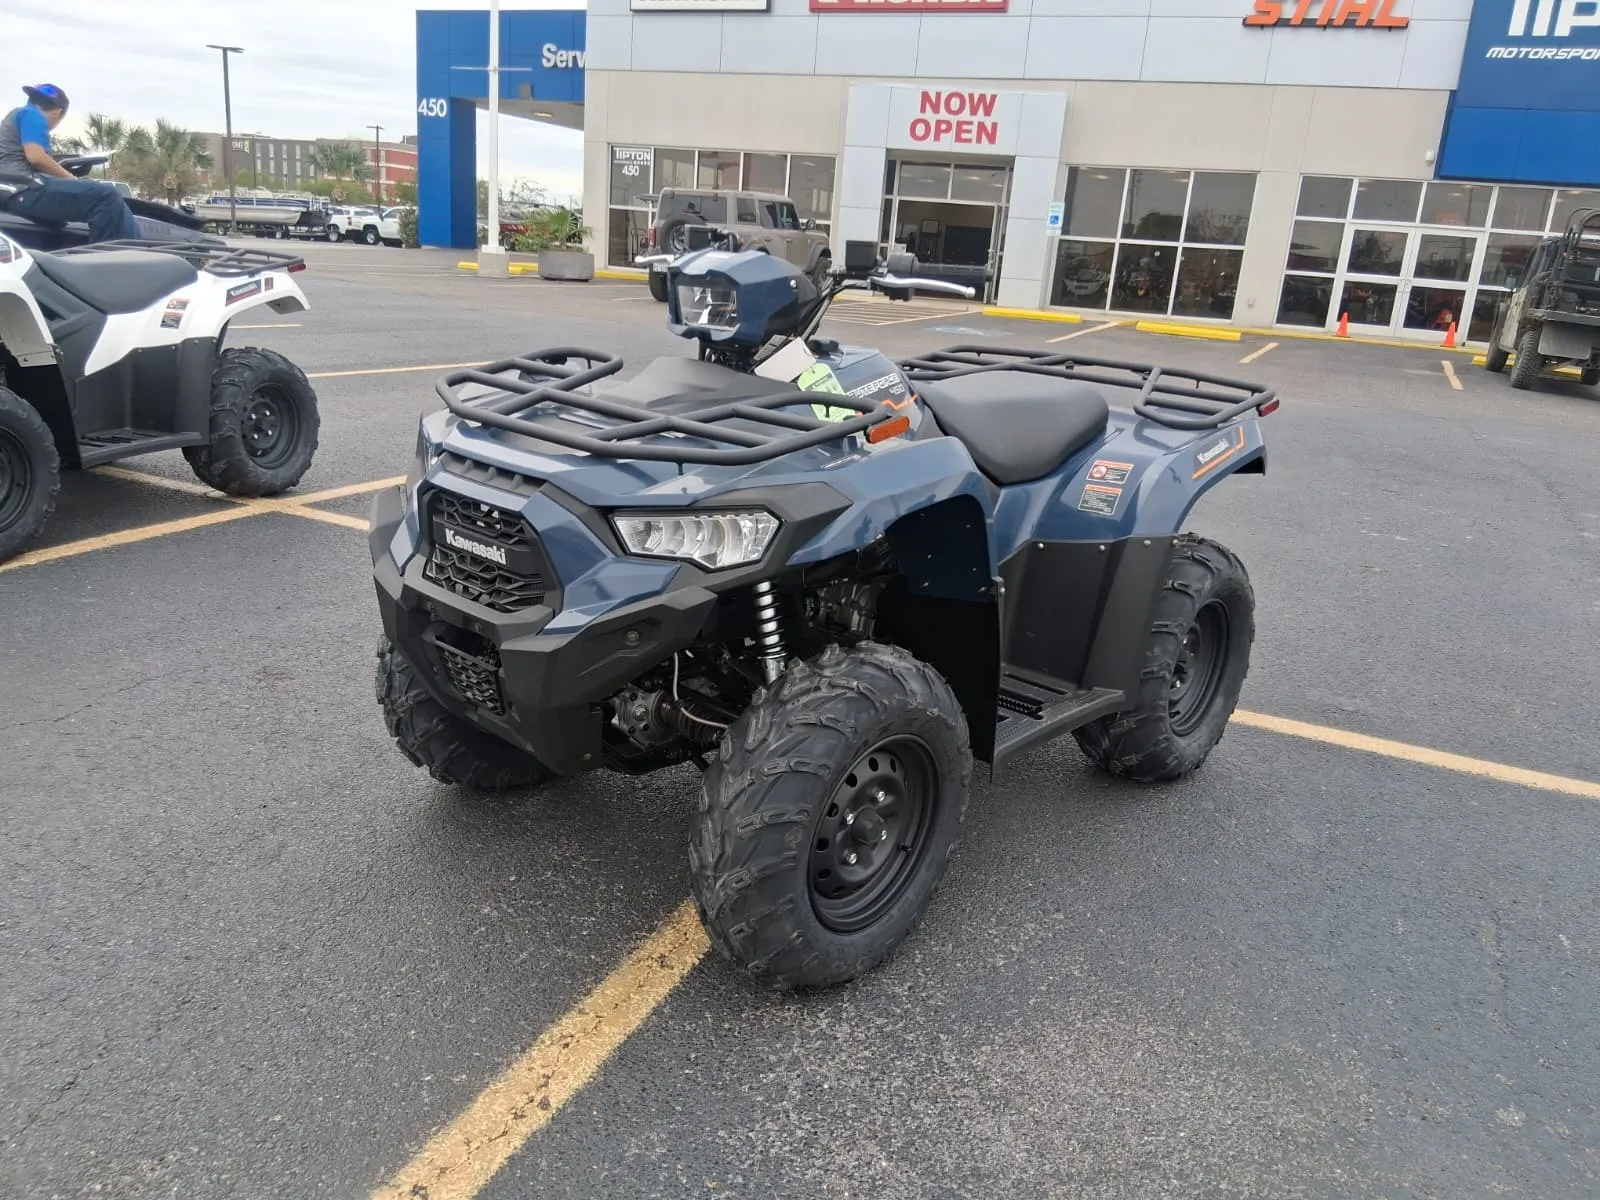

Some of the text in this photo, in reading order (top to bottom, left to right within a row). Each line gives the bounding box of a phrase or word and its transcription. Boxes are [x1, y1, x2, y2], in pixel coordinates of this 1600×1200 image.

[1245, 0, 1409, 26] STIHL
[542, 43, 586, 68] Serv
[418, 98, 447, 117] 450
[920, 91, 997, 117] NOW
[909, 118, 998, 145] OPEN
[613, 147, 650, 160] TIPTON
[622, 165, 640, 176] 450
[889, 383, 904, 395] 450
[445, 528, 506, 565] Kawasaki
